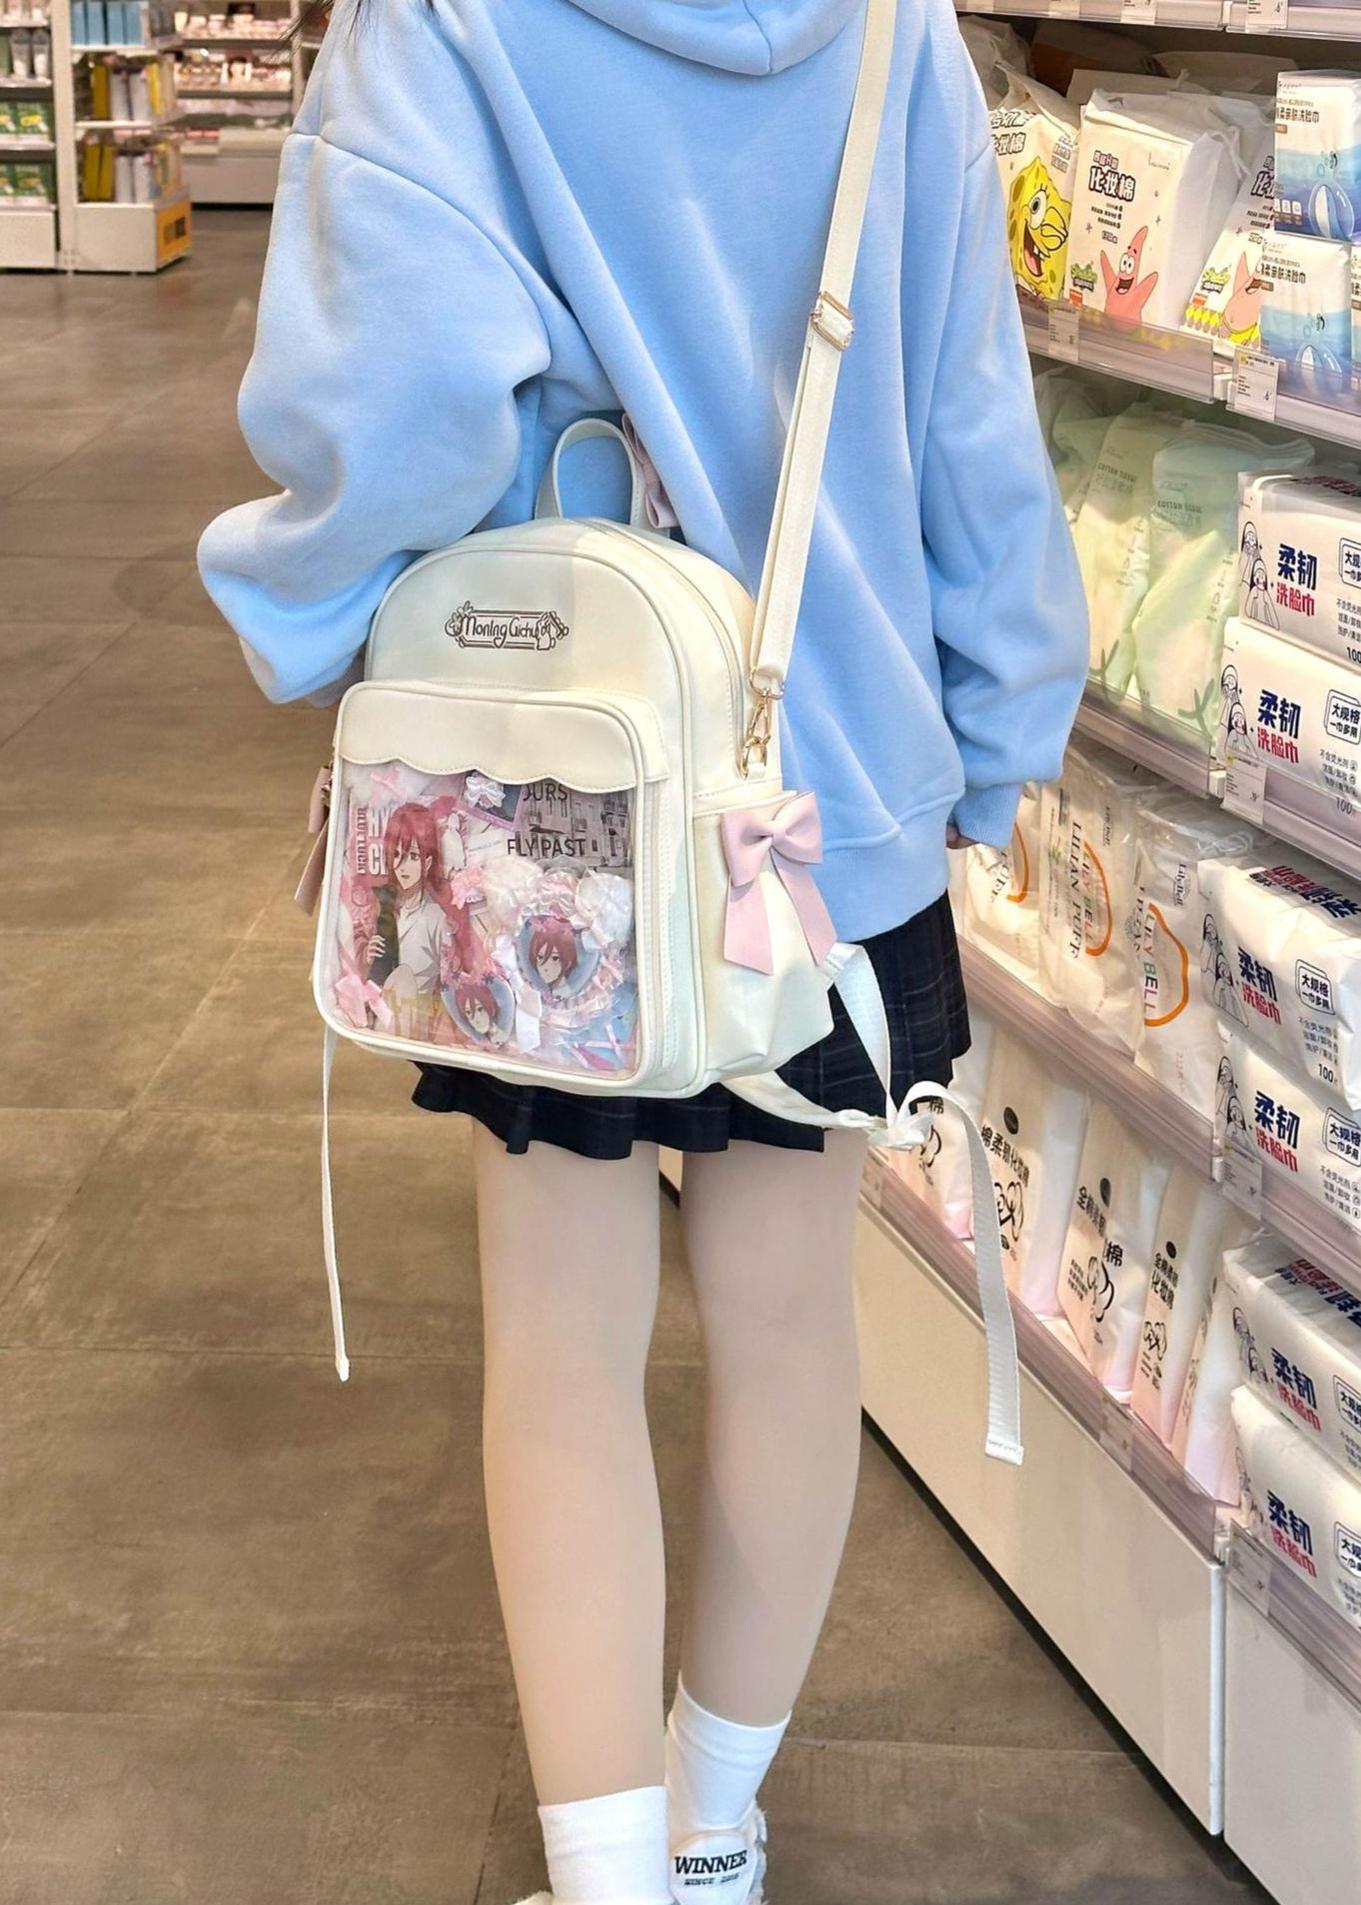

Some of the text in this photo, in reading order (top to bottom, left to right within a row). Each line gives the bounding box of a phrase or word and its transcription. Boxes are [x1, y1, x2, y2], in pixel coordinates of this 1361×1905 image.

[1089, 165, 1136, 202] 化妆棉
[1278, 543, 1318, 590] 柔韧
[1276, 582, 1315, 616] 洗脸巾
[1257, 689, 1301, 739] 柔韧
[1332, 703, 1360, 725] 大规格
[1257, 727, 1299, 764] 洗脸巾
[1238, 946, 1278, 1002] 柔韧
[1301, 974, 1328, 997] 大规格
[1241, 981, 1282, 1025] 洗脸巾
[1319, 1063, 1334, 1083] 100
[1254, 1090, 1300, 1149] 柔韧
[1329, 1122, 1361, 1147] 大规格
[1255, 1127, 1299, 1173] 洗脸巾
[1271, 1347, 1318, 1409] 柔韧
[1277, 1381, 1322, 1431] 洗脸巾
[1267, 1489, 1313, 1556] 柔韧
[1271, 1525, 1318, 1578] 洗脸巾
[674, 1849, 748, 1875] WINNER
